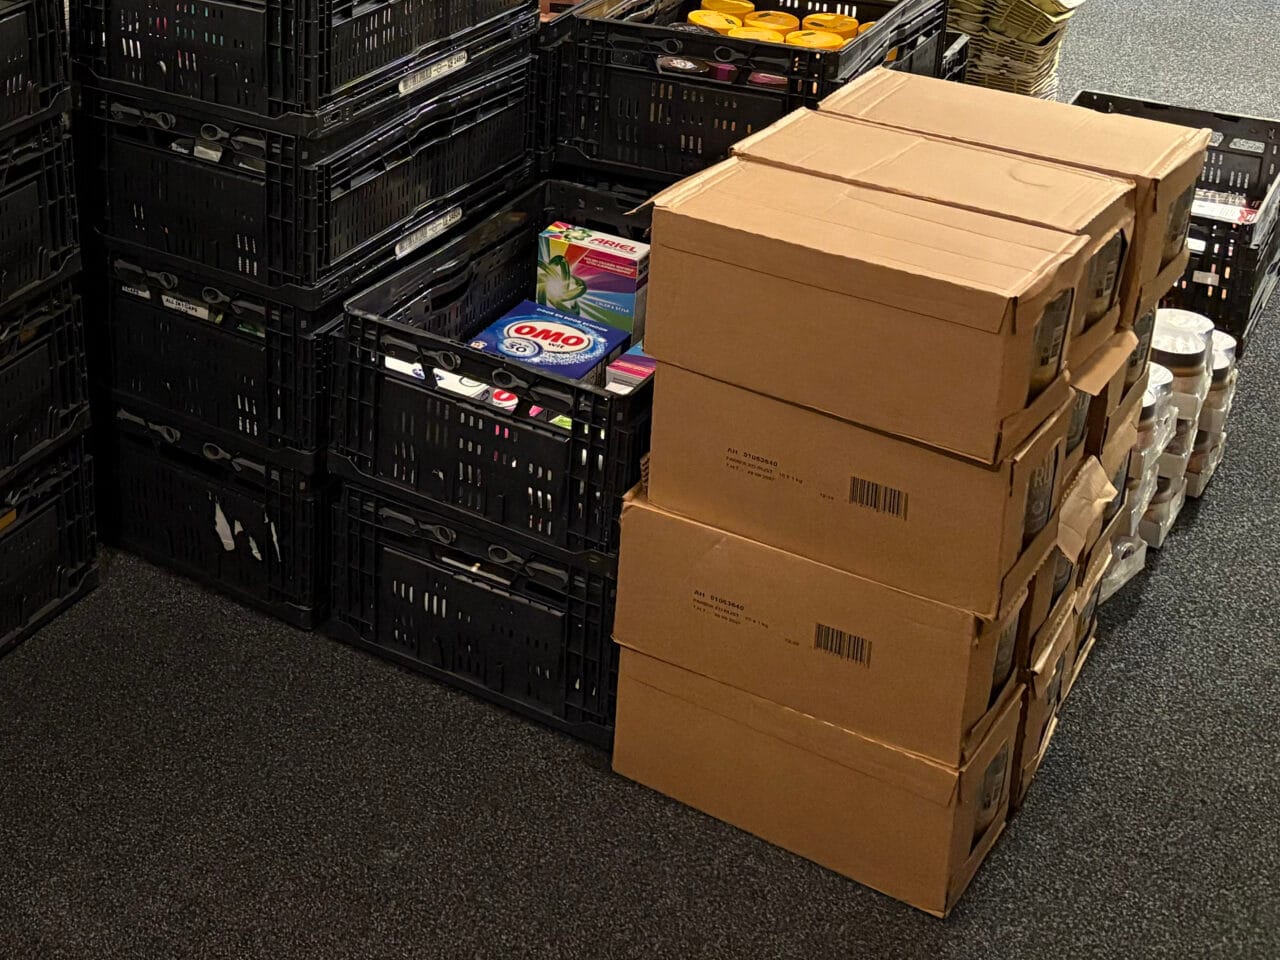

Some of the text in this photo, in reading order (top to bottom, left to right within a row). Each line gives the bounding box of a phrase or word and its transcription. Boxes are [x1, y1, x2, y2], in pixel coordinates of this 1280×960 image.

[588, 237, 637, 253] ARIEL
[514, 325, 585, 347] OMO
[548, 342, 565, 350] wit
